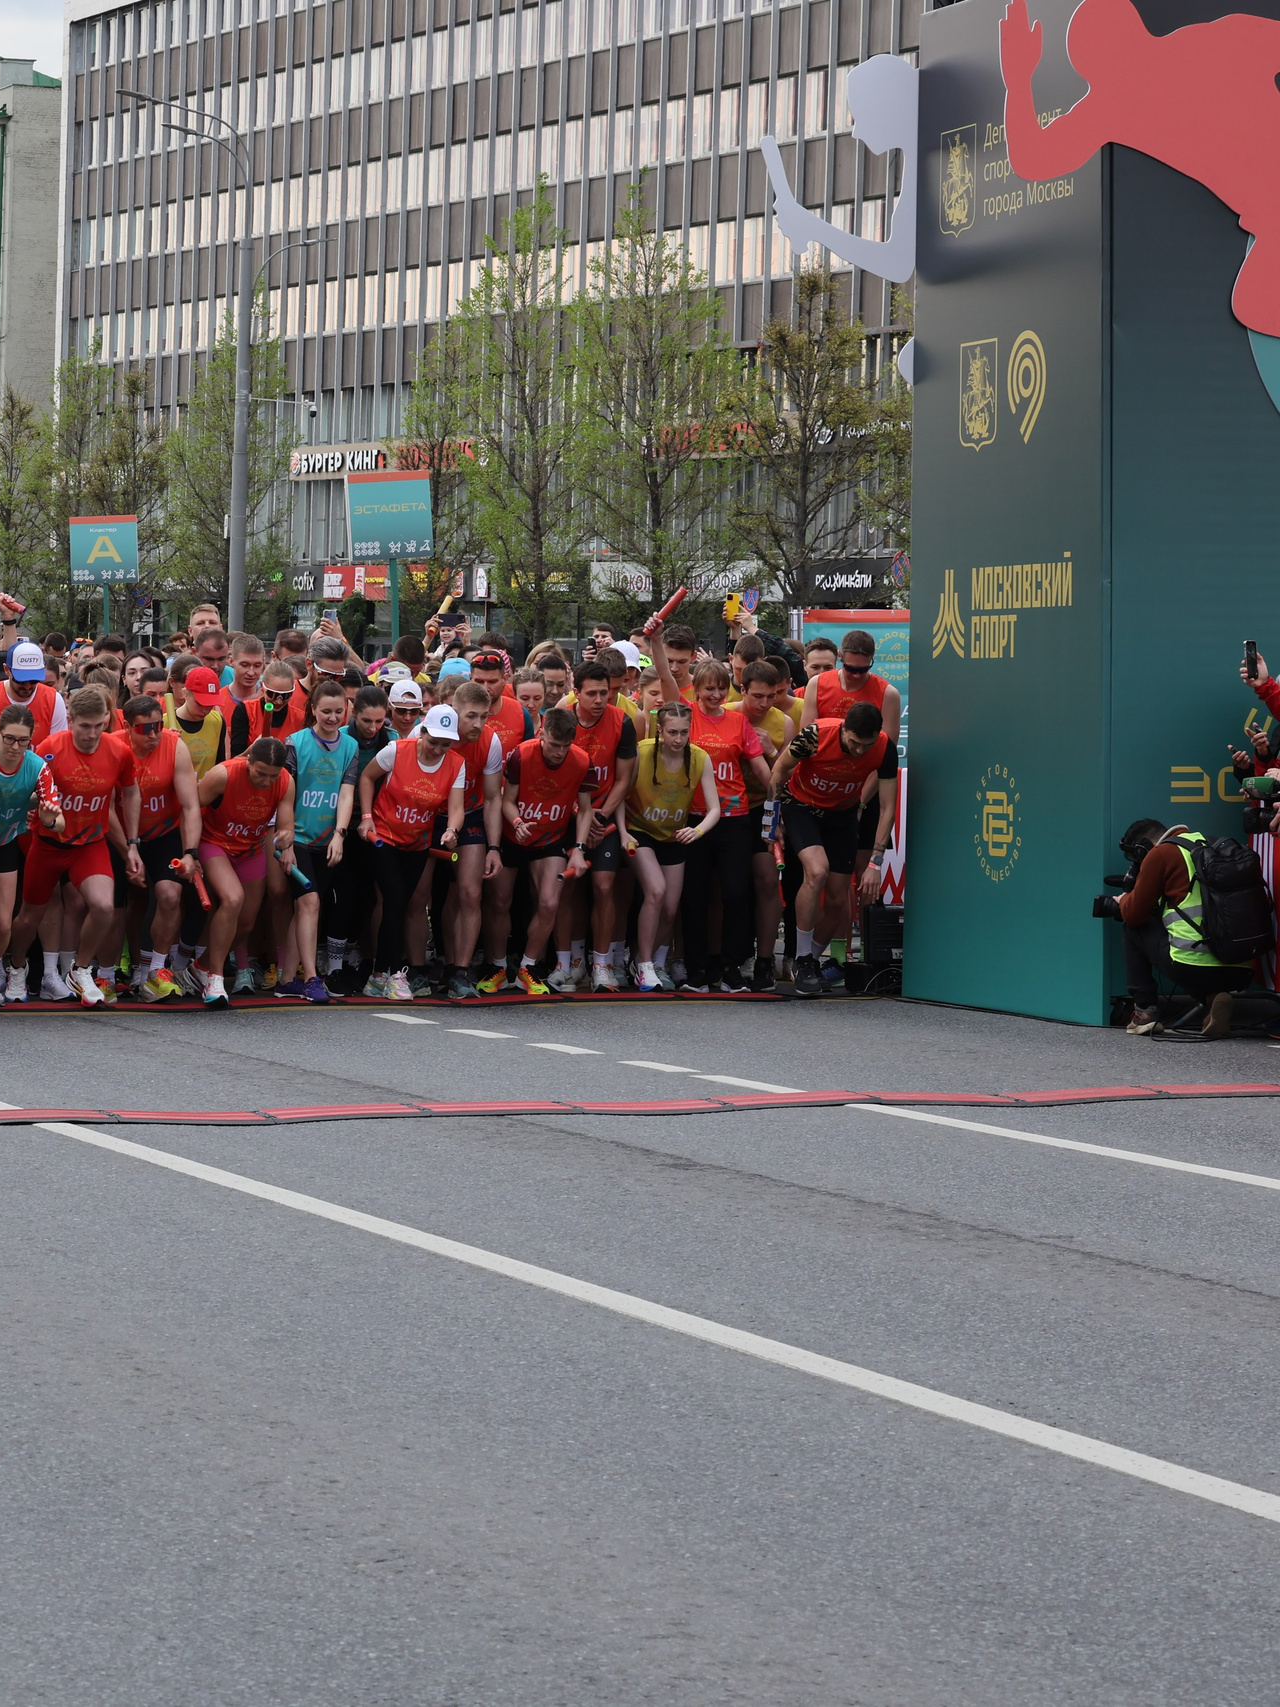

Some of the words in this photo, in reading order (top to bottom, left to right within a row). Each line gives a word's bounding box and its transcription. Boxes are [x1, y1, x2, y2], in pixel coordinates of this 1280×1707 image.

[983, 190, 1024, 221] города
[1026, 177, 1074, 207] Москвы
[300, 452, 344, 474] БУРГЕР
[346, 450, 379, 471] КИНГ
[354, 502, 427, 515] ЭСТАФЕТА
[292, 571, 316, 592] cofix
[971, 551, 1073, 611] МОСКОВСКИЙ
[970, 614, 1018, 659] СПОРТ
[302, 790, 339, 809] 027-0
[226, 821, 269, 836] 294-0
[974, 834, 1022, 884] СООБЩЕСТВО
